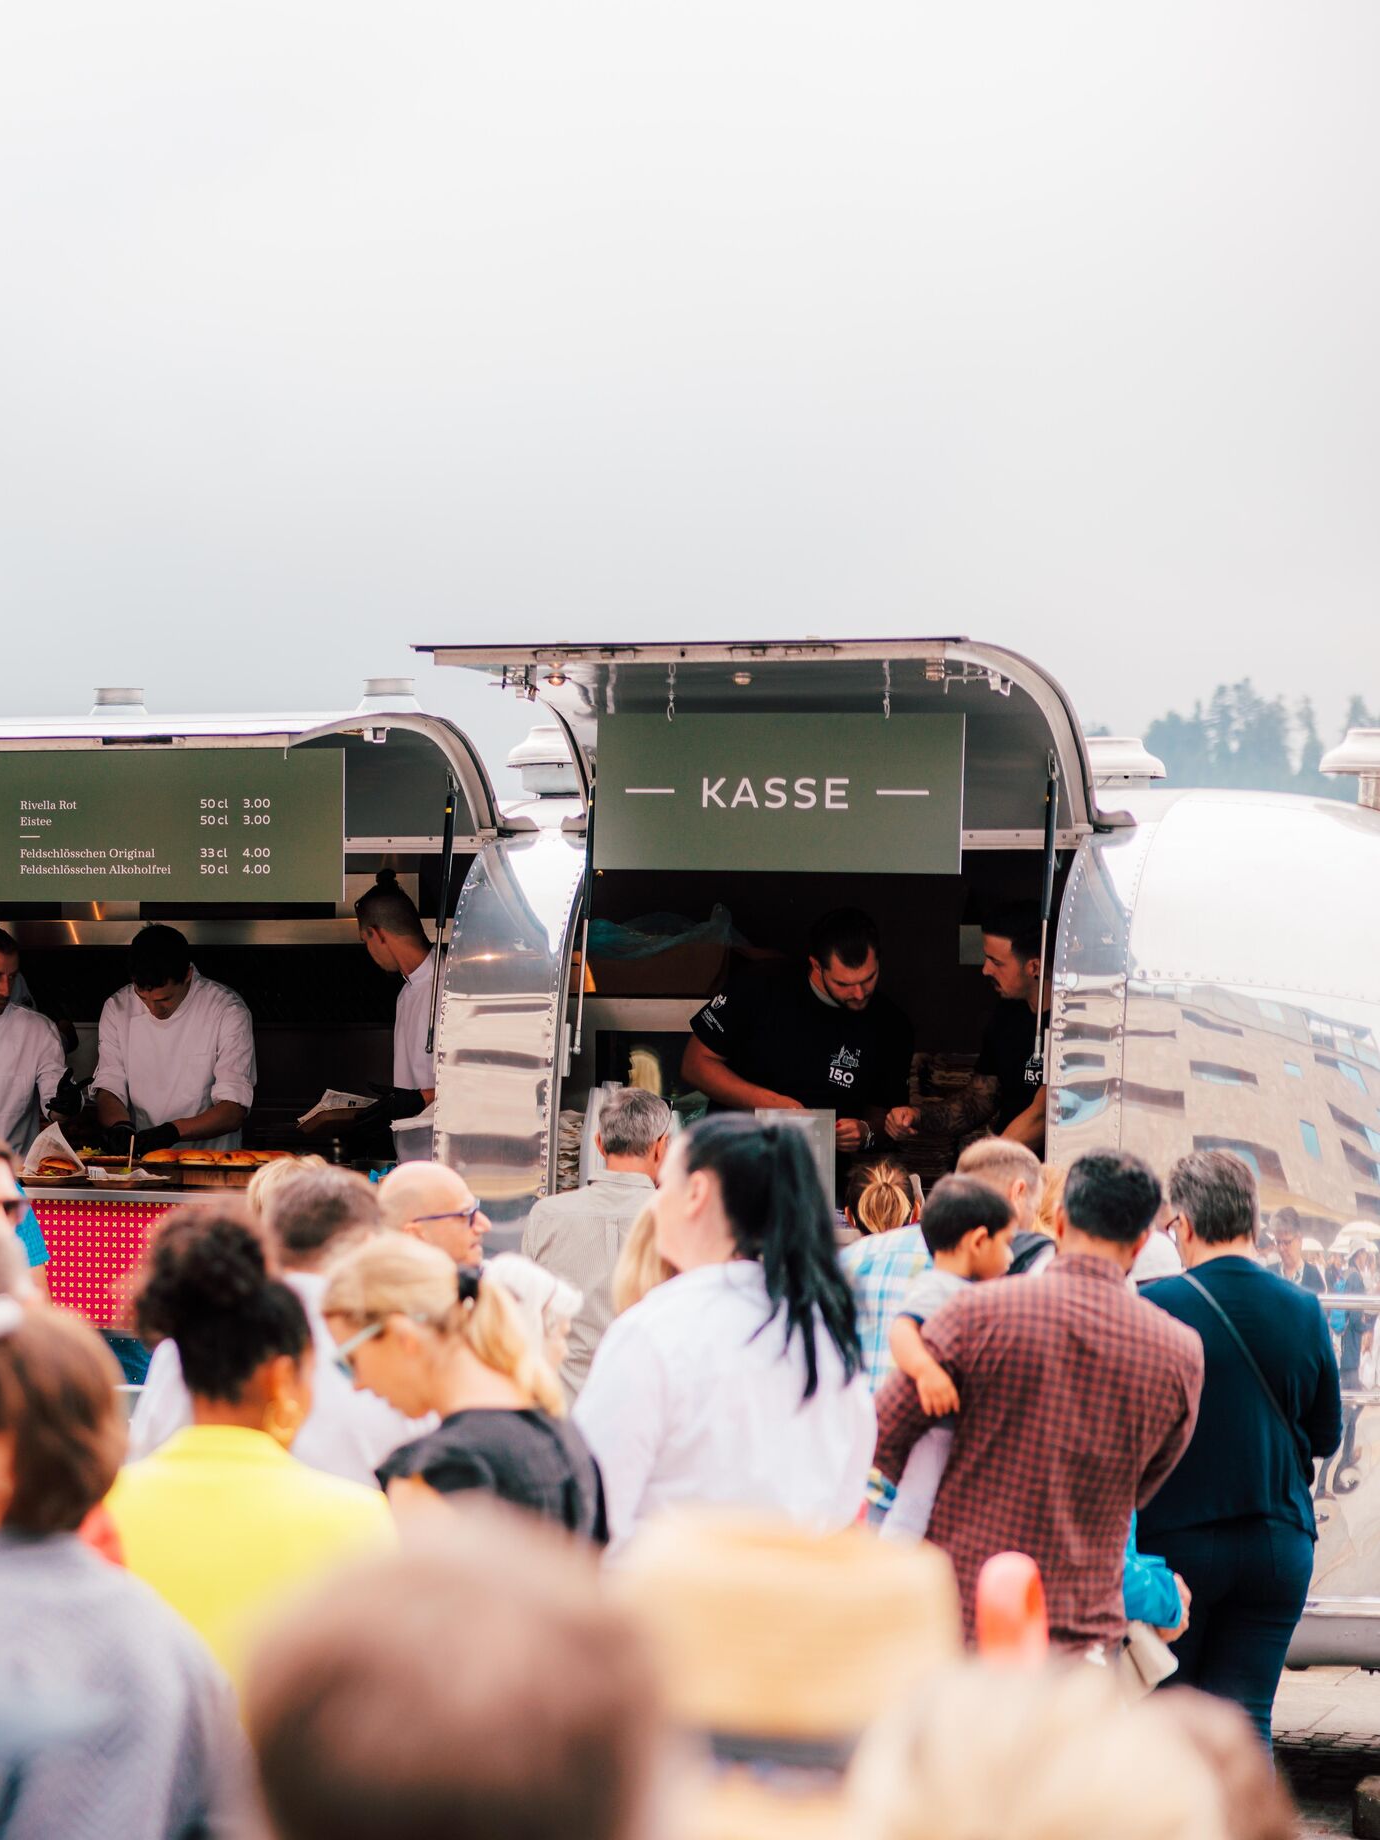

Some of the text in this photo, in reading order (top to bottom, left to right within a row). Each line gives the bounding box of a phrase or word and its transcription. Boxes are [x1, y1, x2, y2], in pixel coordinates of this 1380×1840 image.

[701, 777, 850, 810] KASSE
[20, 798, 271, 810] Rivella Rot 50 cl 3.00
[20, 814, 271, 827] Eistee 50 cl 3.00
[20, 847, 271, 861] Feldschlösschen Original 33 cl 4.00
[20, 864, 271, 875] Feldschlösschen Alkoholfrei 50 cl 4.00
[828, 1066, 855, 1084] 150
